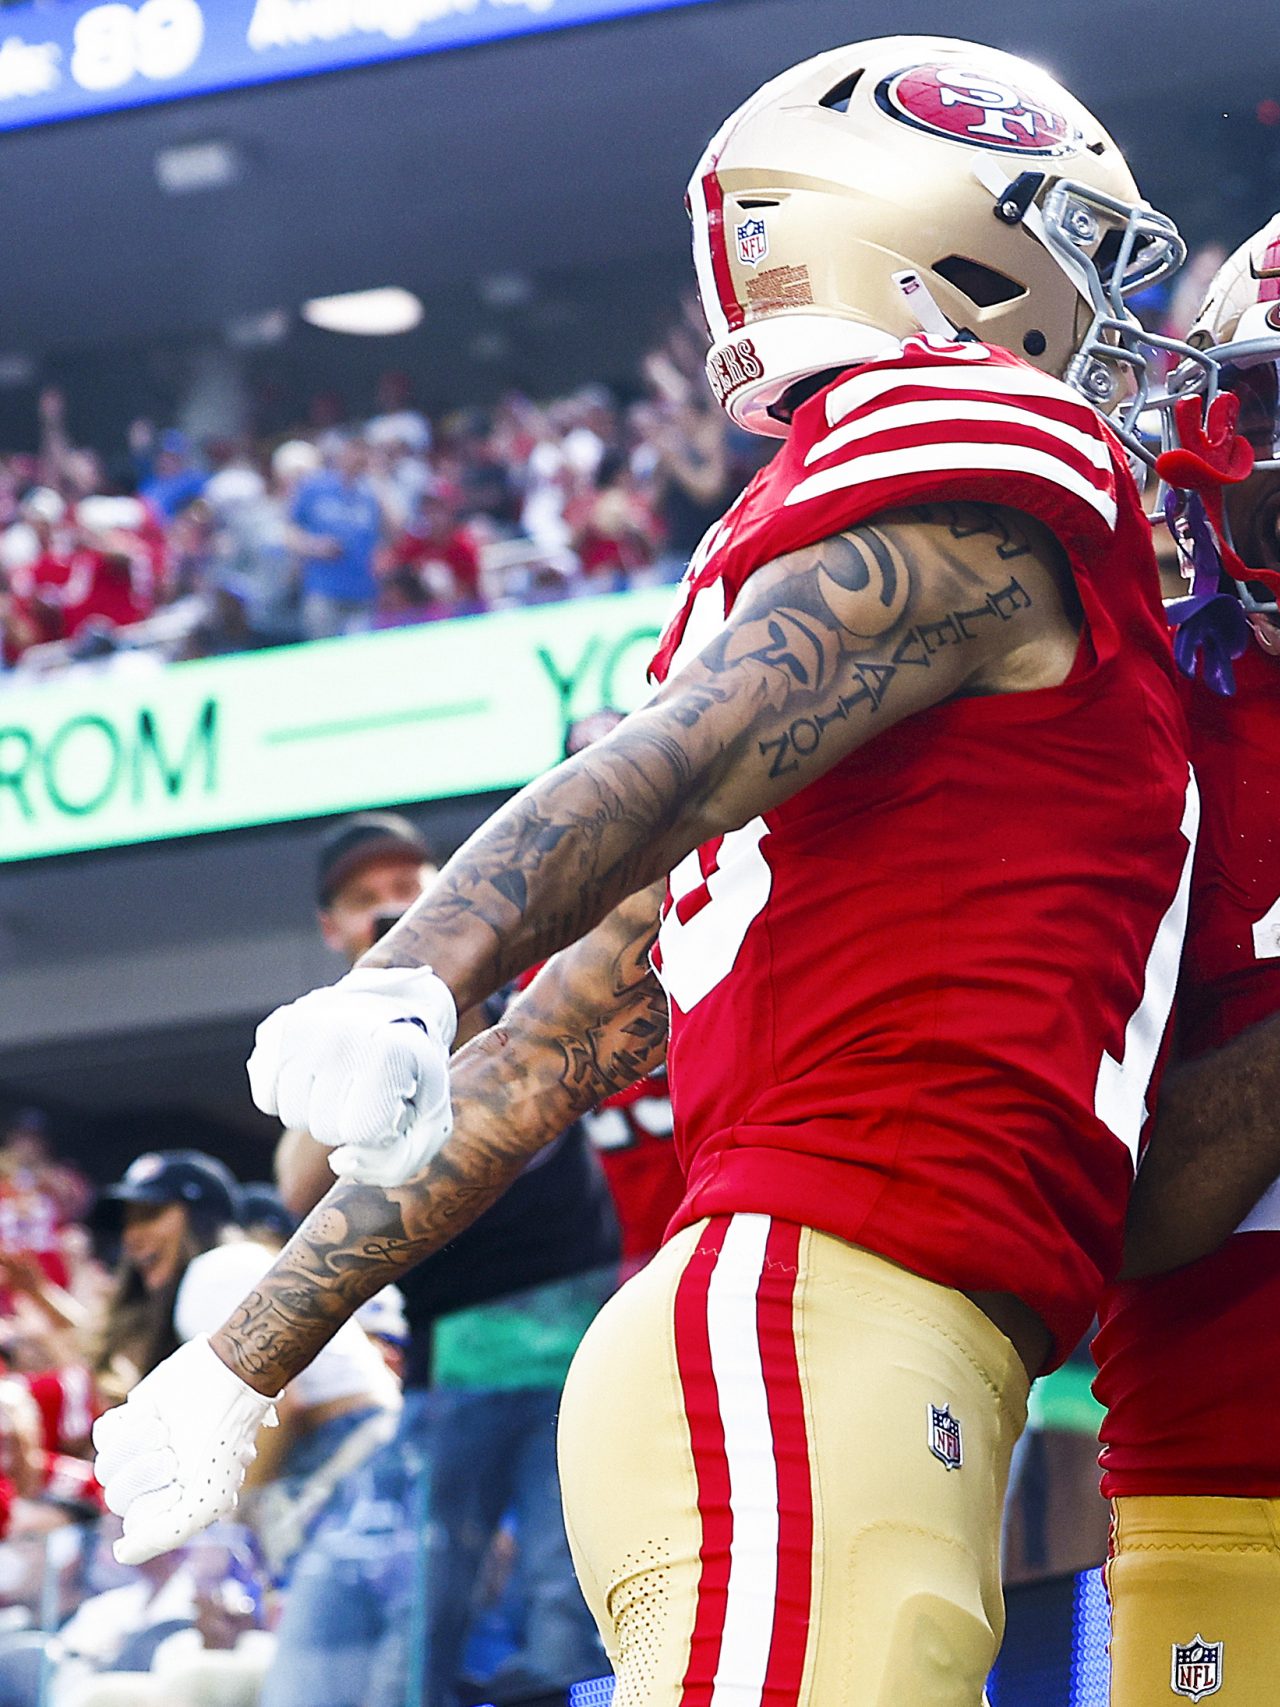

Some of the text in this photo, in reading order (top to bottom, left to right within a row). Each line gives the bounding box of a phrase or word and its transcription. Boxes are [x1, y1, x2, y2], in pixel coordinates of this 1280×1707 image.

[741, 235, 766, 258] NFL
[705, 338, 765, 407] ERS
[758, 575, 1032, 779] ELEVATION
[936, 1428, 961, 1458] NFL
[1180, 1665, 1213, 1690] NFL
